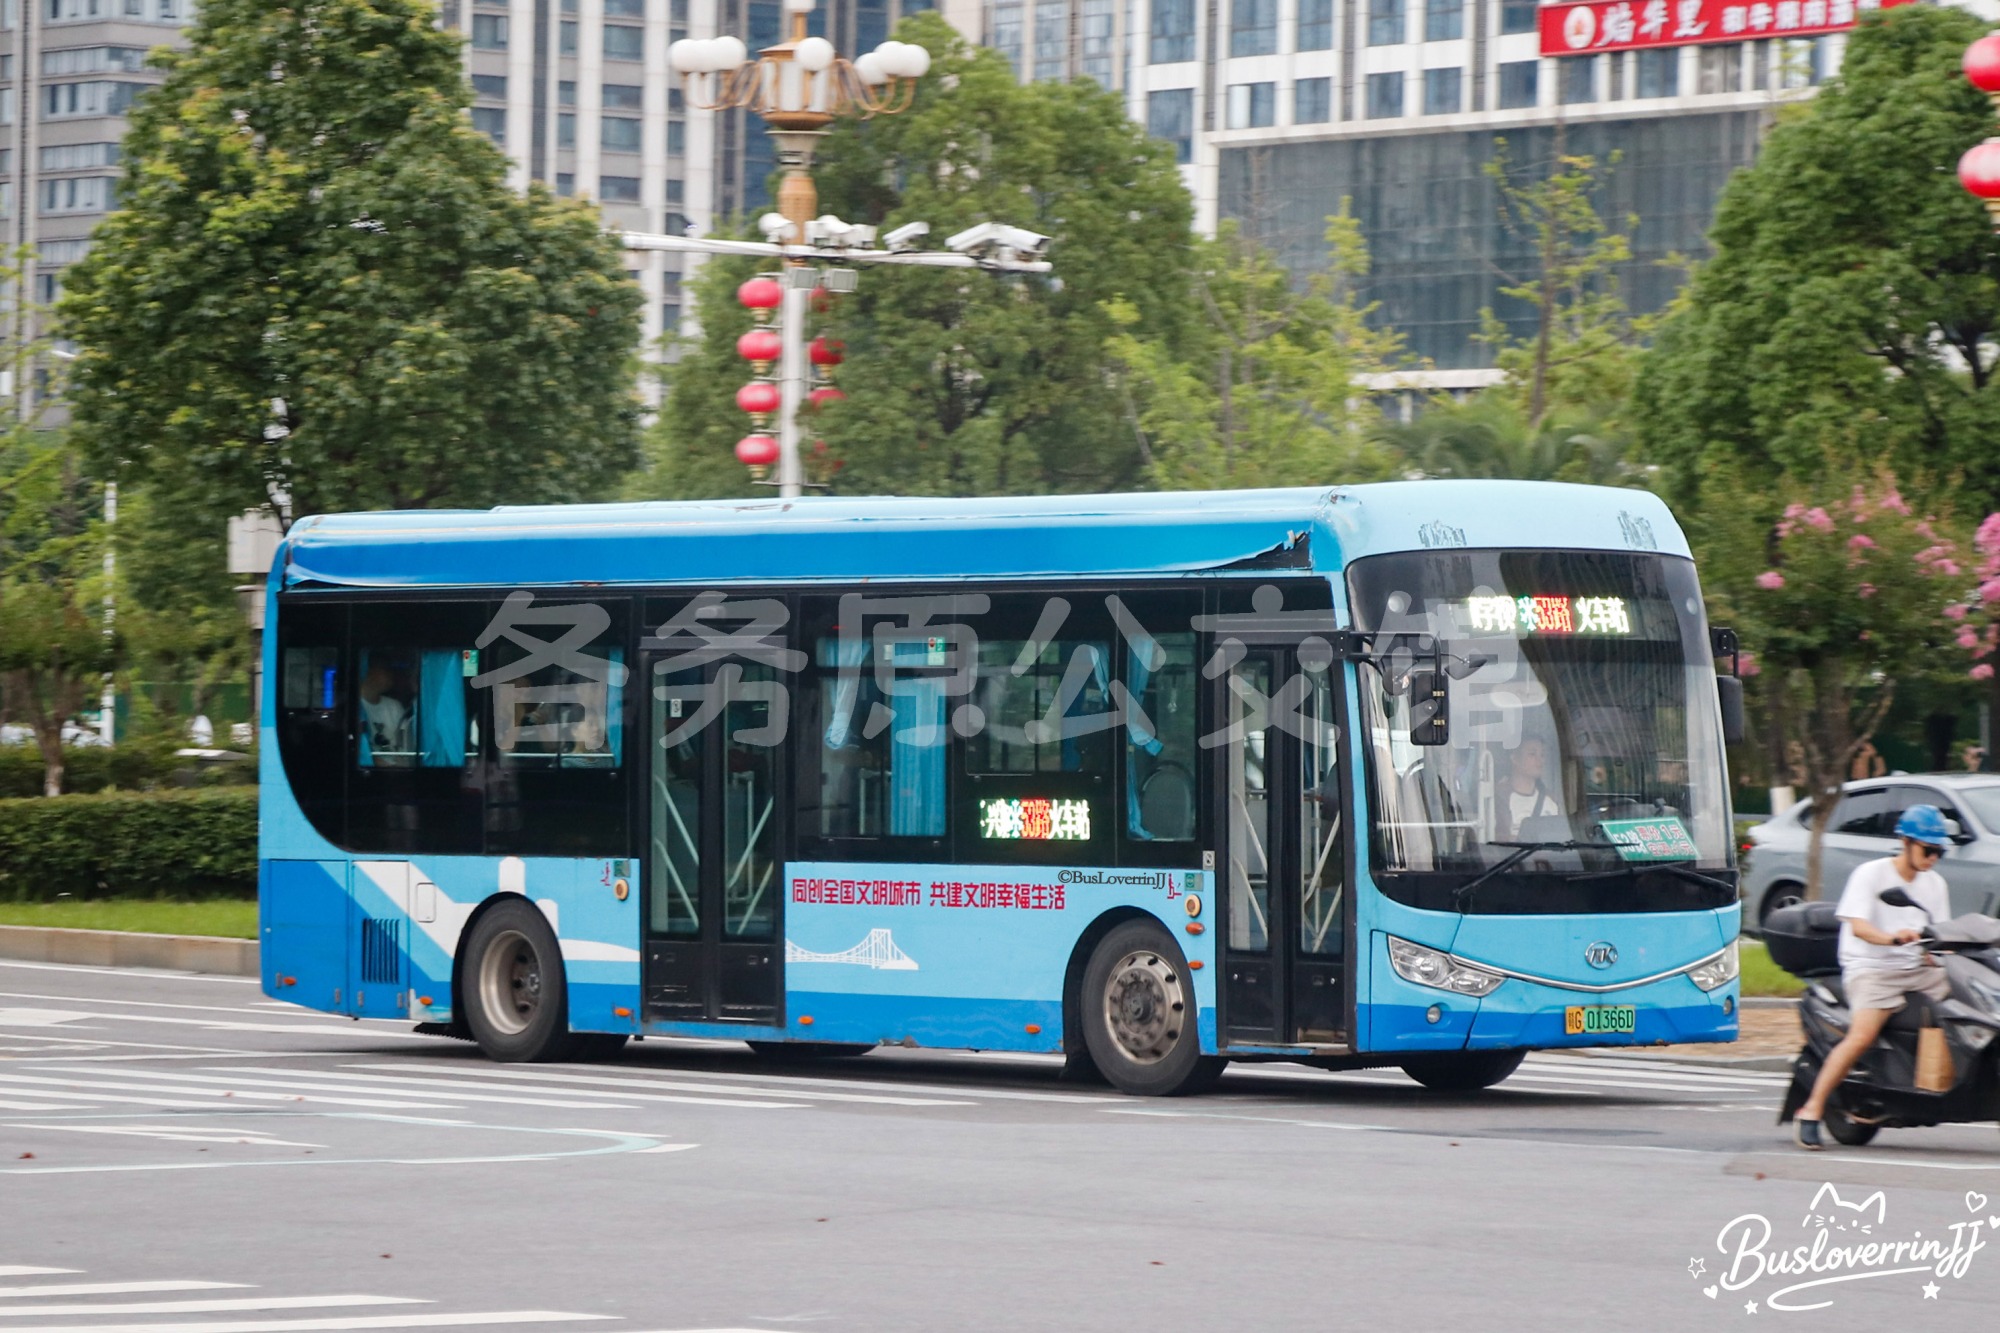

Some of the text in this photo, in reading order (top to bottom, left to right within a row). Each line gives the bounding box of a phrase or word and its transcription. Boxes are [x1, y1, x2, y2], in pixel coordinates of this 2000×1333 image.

[1575, 596, 1630, 632] 火车站
[1049, 799, 1091, 840] 火车站
[792, 879, 1066, 910] 同创全国文明城市 共建文明幸福生活
